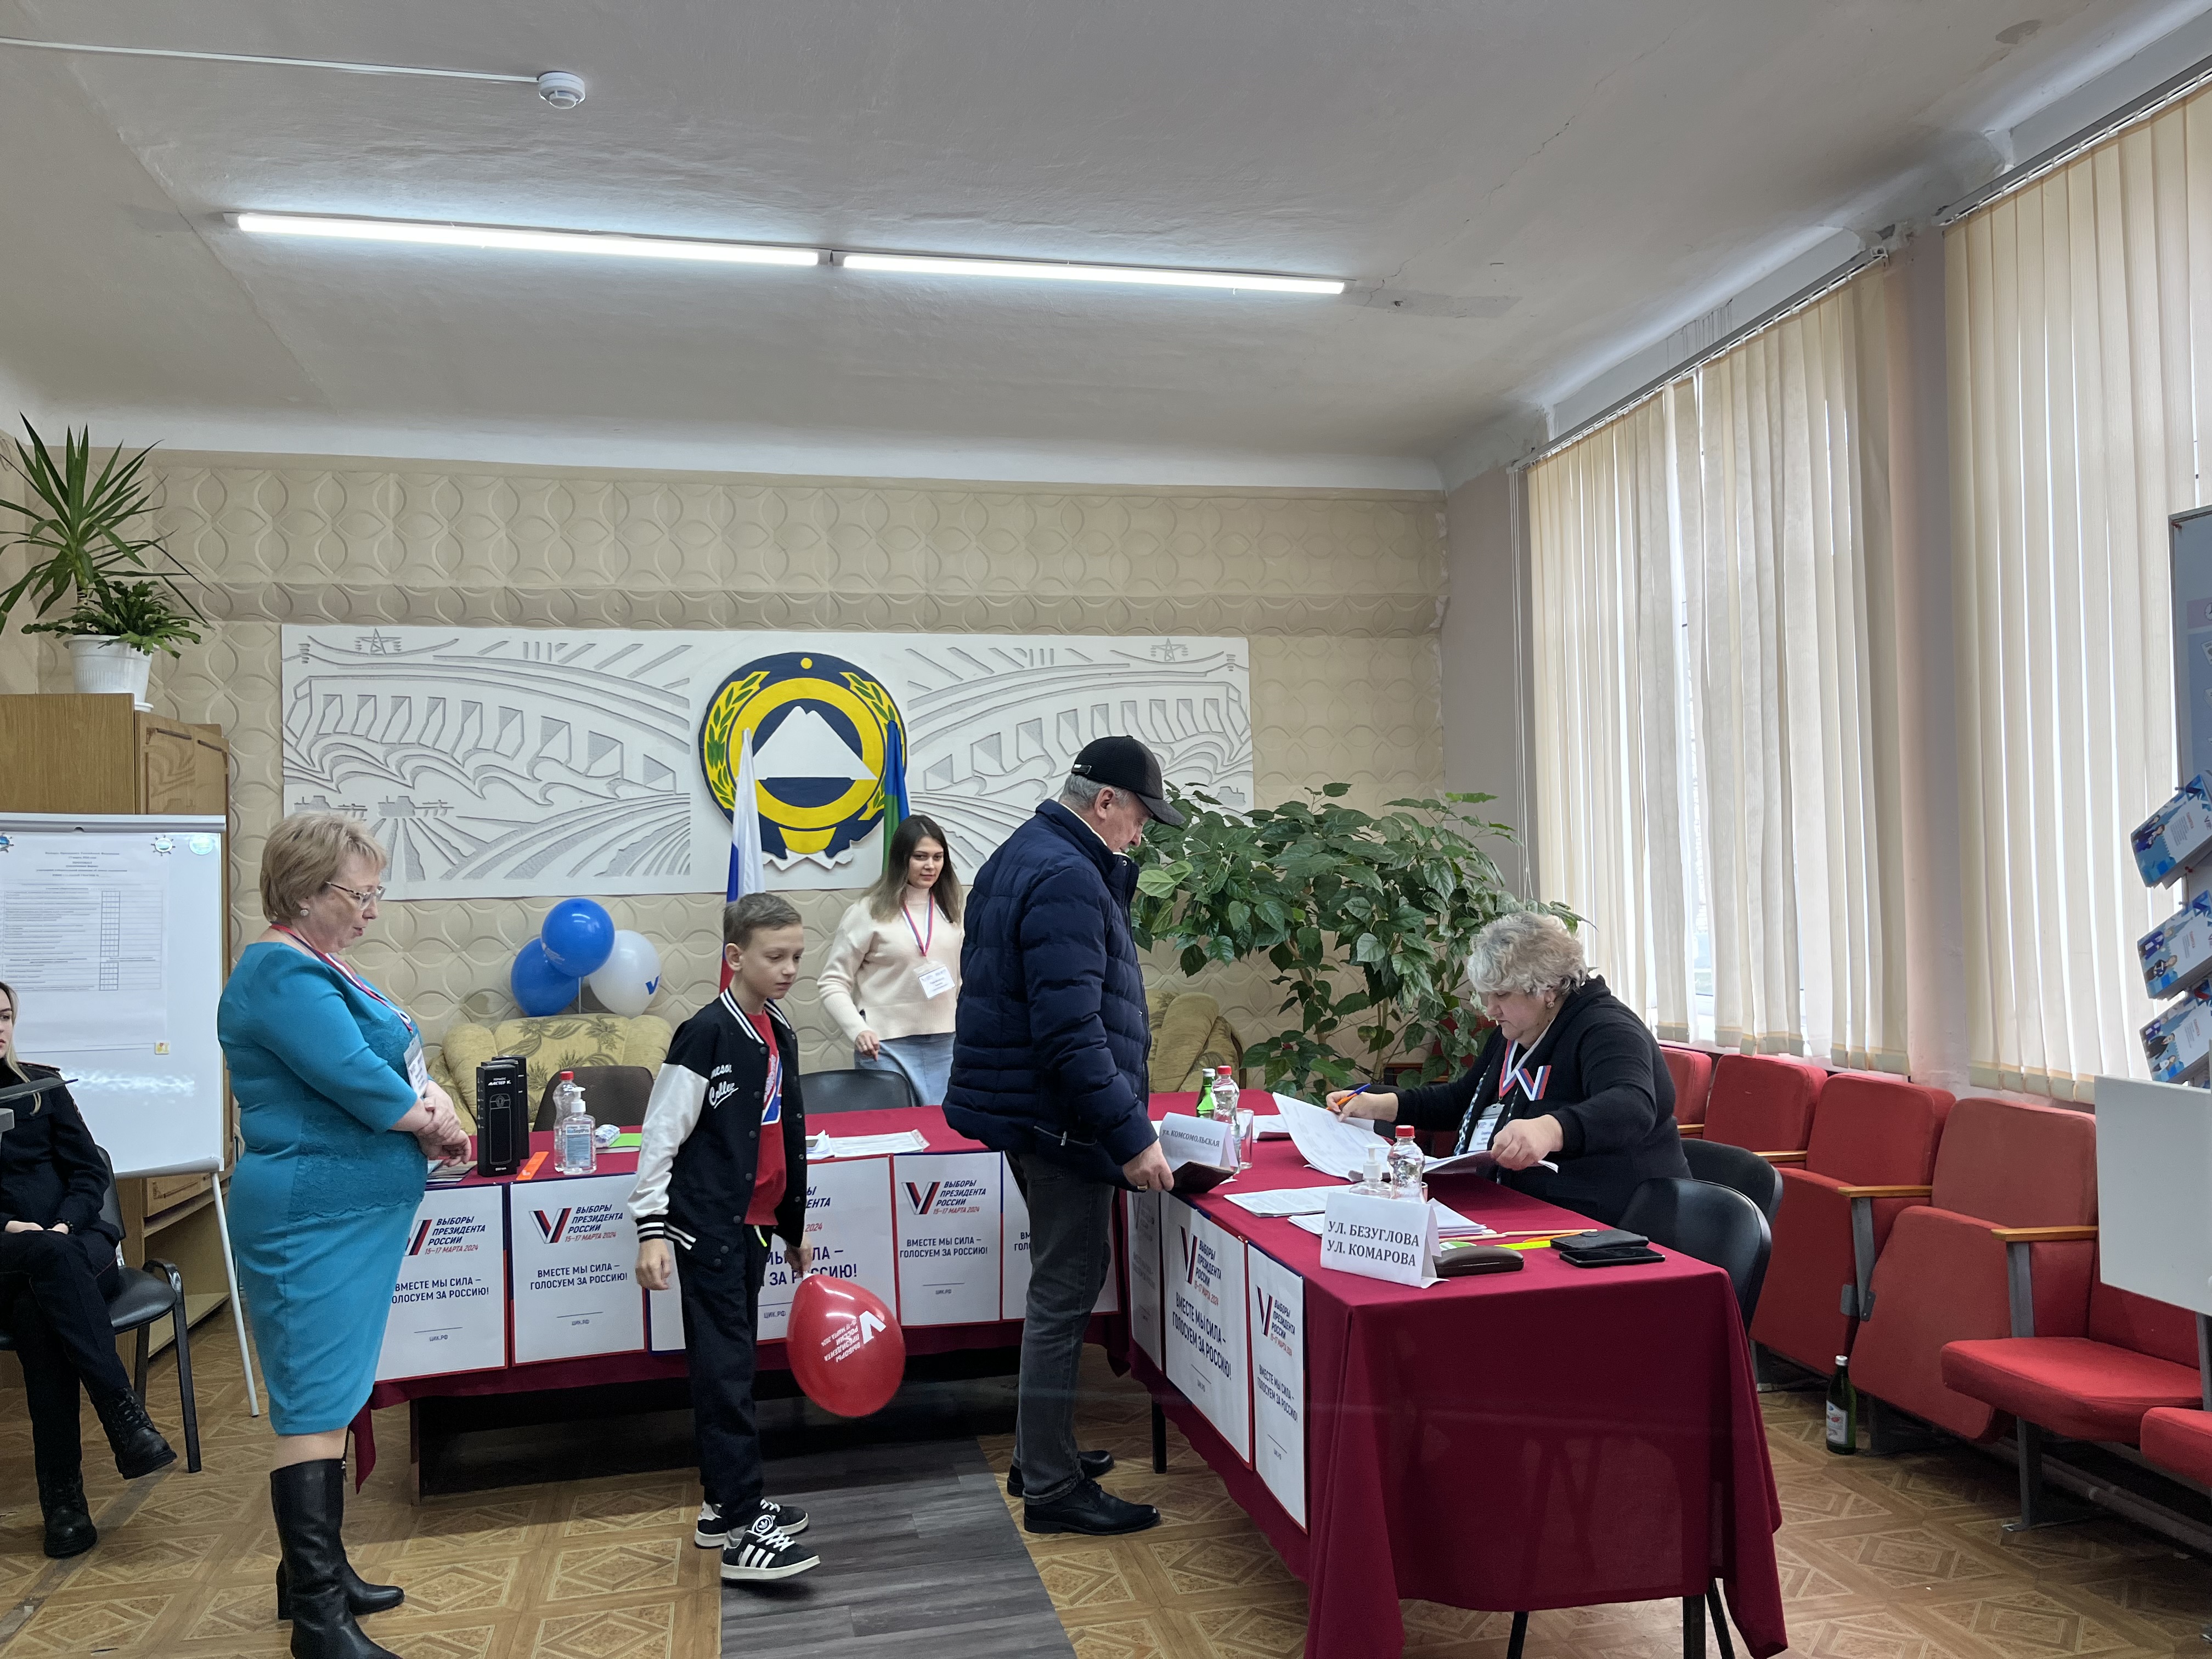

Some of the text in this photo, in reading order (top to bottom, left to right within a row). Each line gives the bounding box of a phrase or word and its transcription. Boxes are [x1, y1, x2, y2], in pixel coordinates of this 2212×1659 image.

[1171, 1130, 1220, 1147] КОМСОМОЛЬСКАЯ
[944, 1180, 977, 1188] ВЫБОРЫ
[940, 1188, 986, 1197] ПРЕЗИДЕНТА
[575, 1204, 612, 1214] ВЫБОРЫ
[436, 1216, 475, 1226] ВЫБОРЫ
[571, 1212, 623, 1224] ПРЕЗИДЕНТА
[432, 1225, 486, 1236] ПРЕЗИДЕНТА
[567, 1224, 601, 1234] РОССИИ
[805, 1222, 823, 1232] 2024
[1328, 1221, 1420, 1247] УЛ. БЕЗУГЛОВА
[428, 1237, 462, 1246] РОССИИ
[907, 1239, 936, 1247] ВМЕСТЕ
[939, 1238, 952, 1246] МЫ
[955, 1237, 974, 1245] СИЛА
[812, 1246, 830, 1260] ЛА
[900, 1246, 988, 1259] ГОЛОСУЕМ ЗА РОССИЮ!
[1199, 1240, 1216, 1261] ВЫБОРЫ
[1327, 1240, 1416, 1267] УЛ. КОМАРОВА
[538, 1267, 570, 1278] ВМЕСТЕ
[572, 1265, 588, 1274] МЫ
[590, 1263, 612, 1273] СИЛА
[1197, 1254, 1222, 1280] ПРЕЗИДЕНТА
[395, 1280, 429, 1292] ВМЕСТЕ
[432, 1279, 447, 1288] МЫ
[450, 1277, 473, 1286] СИЛА
[530, 1272, 628, 1290] ГОЛОСУЕМ ЗА РОССИЮ!
[769, 1272, 787, 1285] ЗА
[1195, 1267, 1210, 1287] РОССИИ
[392, 1286, 489, 1304] ОЛОСУЕМ ЗА РОССИЮ!
[764, 1311, 786, 1319] ЦИК.РФ
[1176, 1291, 1194, 1322] ВМЕСТЕ
[1195, 1308, 1205, 1331] МЫ
[1206, 1318, 1222, 1345] СИЛА
[836, 1325, 859, 1346] РОССИИ
[824, 1334, 860, 1362] ПРЕЗИДЕНТА
[836, 1342, 860, 1363] ВЫБОРЫ
[1172, 1311, 1232, 1381] ГОЛОСУЕМ ЗА РОССИЮ!
[1259, 1364, 1273, 1385] ВМЕСТЕ
[1274, 1376, 1281, 1392] МЫ
[1281, 1383, 1291, 1401] СИЛА
[1257, 1376, 1298, 1423] ГОЛОСУЕМ ЗА РОССИЮ!
